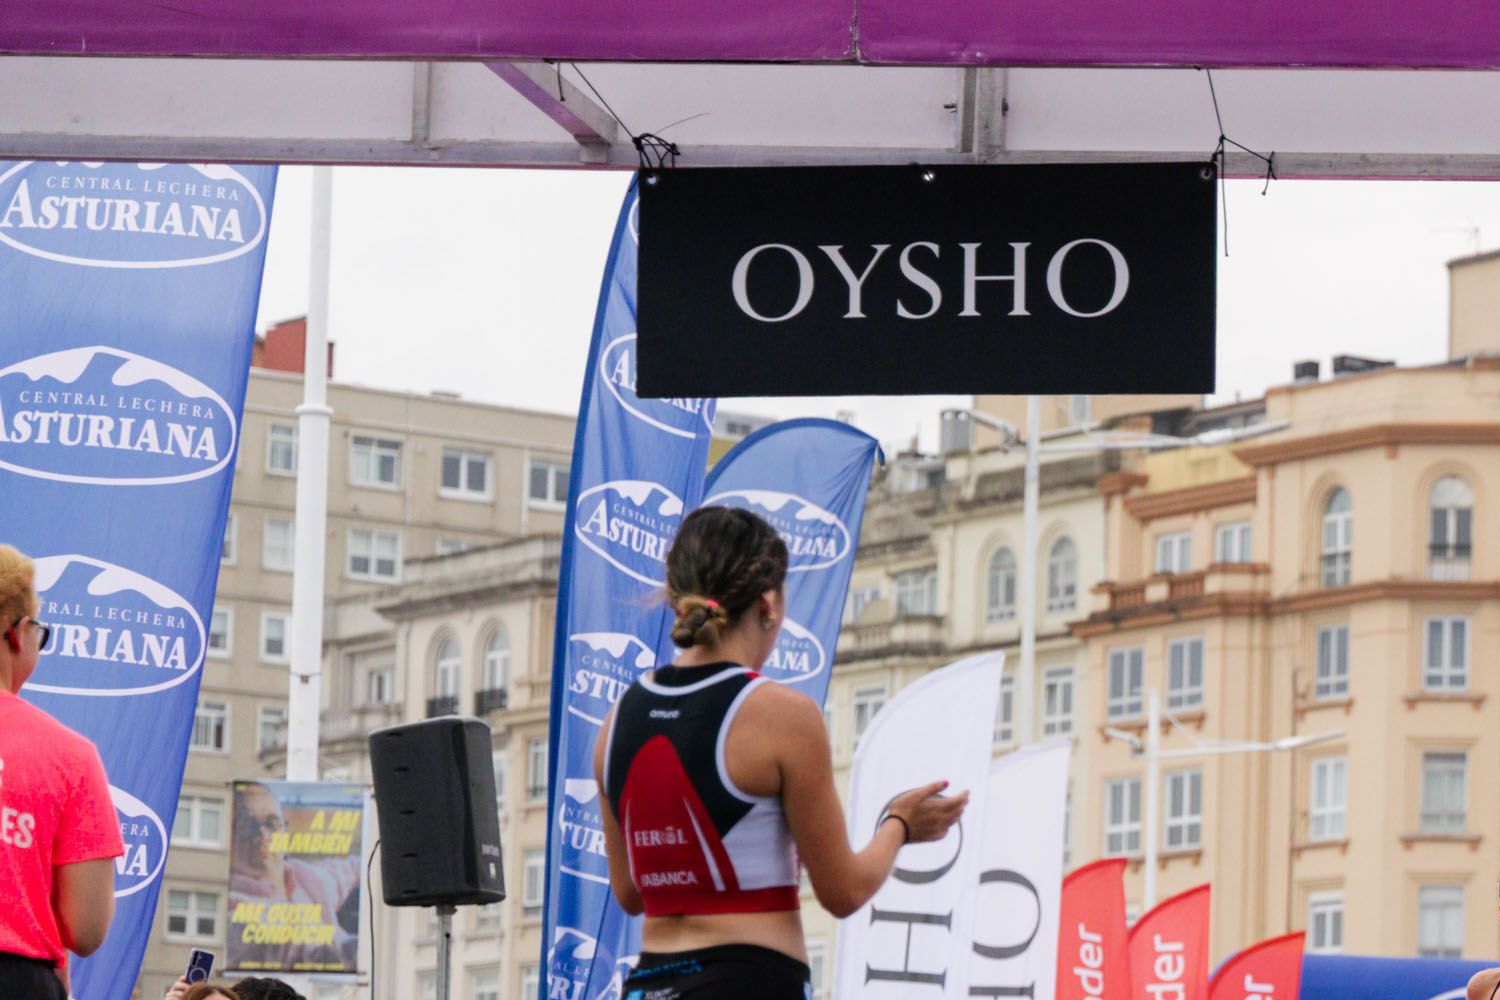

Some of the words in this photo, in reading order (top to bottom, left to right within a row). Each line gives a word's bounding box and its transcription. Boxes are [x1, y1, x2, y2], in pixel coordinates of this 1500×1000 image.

[45, 175, 135, 192] CENTRAL
[143, 177, 240, 201] LECHERA
[0, 178, 246, 244] ASTURIANA
[731, 237, 1131, 323] OYSHO
[19, 390, 109, 407] CENTRAL
[117, 395, 216, 420] LECHERA
[613, 502, 656, 530] CENTRAL
[93, 606, 186, 629] LECHERA
